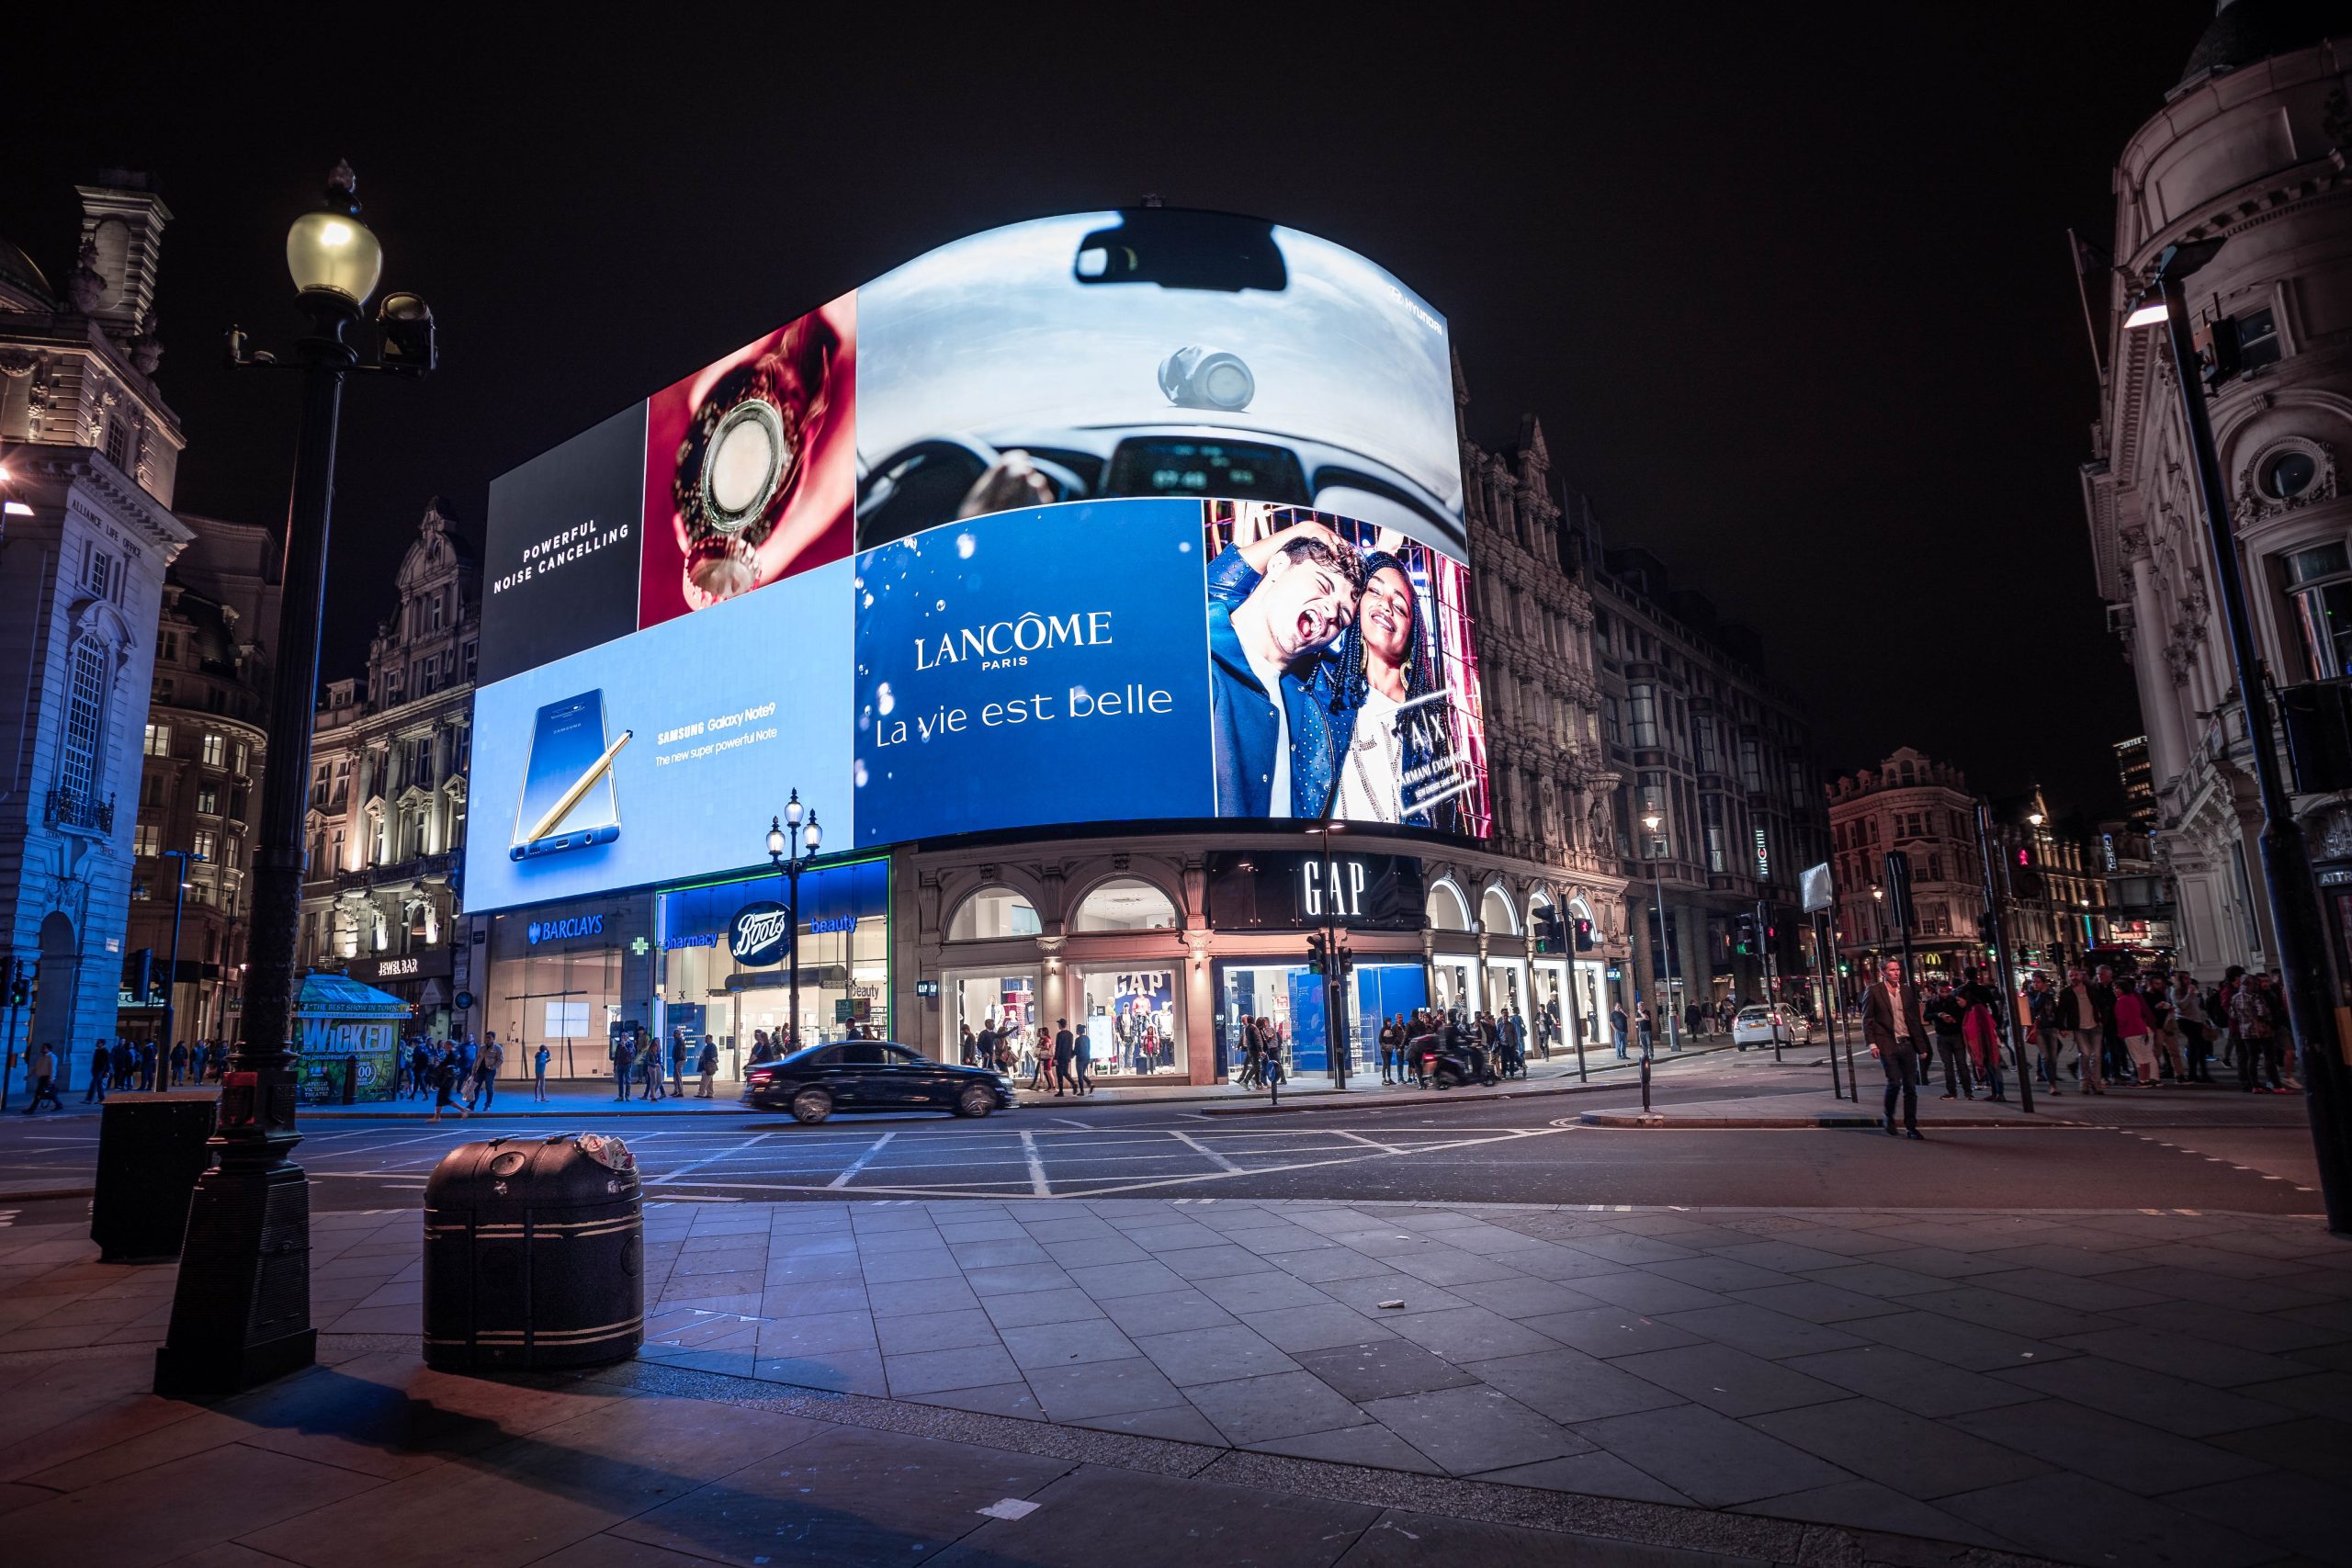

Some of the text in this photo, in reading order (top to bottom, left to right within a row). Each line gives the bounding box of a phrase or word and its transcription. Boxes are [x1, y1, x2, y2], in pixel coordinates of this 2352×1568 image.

[1405, 298, 1442, 336] HYUNDAI
[72, 499, 141, 558] ALLIANCE LIFE OFFICE
[523, 519, 596, 562] POWERFUL
[493, 524, 628, 593] NOISE CANCELLING
[914, 611, 1114, 671] LANCÔME
[981, 656, 1029, 671] PARIS
[657, 702, 776, 746] SAMSUNG Galaxy Note9
[876, 683, 1173, 748] La vie est belle
[655, 728, 778, 767] The new super powerful Note
[1401, 753, 1463, 785] ARMANI EXCHANG
[2104, 839, 2117, 872] LYRIC
[1304, 861, 1365, 916] GAP
[542, 914, 605, 941] BARCLAYS
[663, 932, 718, 953] pharmacy
[732, 909, 786, 956] Boots
[810, 913, 858, 934] beauty
[378, 958, 419, 976] JEWEL BAR
[1114, 972, 1163, 999] GAP
[329, 1003, 345, 1011] BEST
[346, 1003, 367, 1011] SHOW
